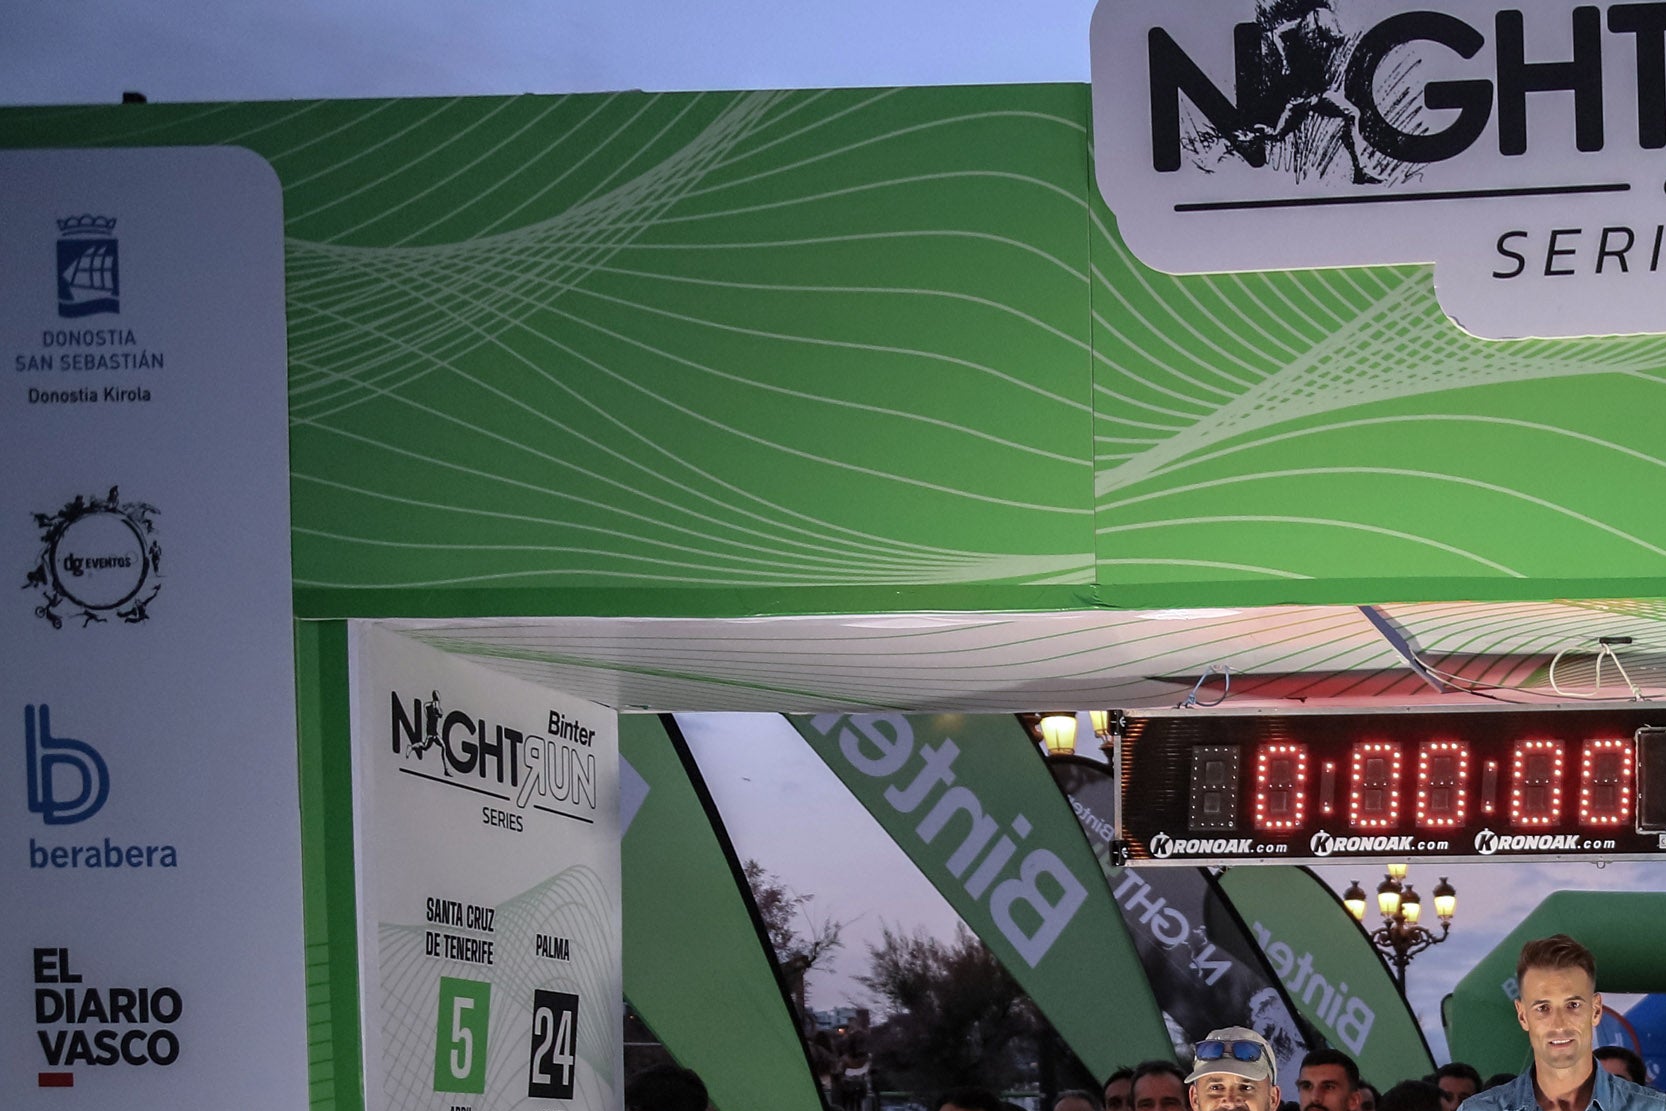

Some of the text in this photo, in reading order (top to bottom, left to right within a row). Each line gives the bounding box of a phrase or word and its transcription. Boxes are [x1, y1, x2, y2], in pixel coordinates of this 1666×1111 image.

[42, 330, 136, 347] DONOSTIA
[15, 350, 164, 372] SAN SEBASTIÁN
[28, 386, 151, 403] Donostia Kirola
[85, 556, 132, 570] EVENTOS
[548, 710, 596, 748] Binter
[483, 807, 523, 832] SERIES
[29, 838, 178, 868] berabera
[426, 898, 495, 932] SANTA CRUZ
[426, 931, 494, 965] DE TENERIFE
[536, 934, 570, 961] PALMA
[33, 947, 83, 984] EL
[34, 987, 183, 1024] DIARIO
[38, 1029, 180, 1067] VASCO
[450, 997, 474, 1079] 5
[532, 1006, 575, 1087] 24
